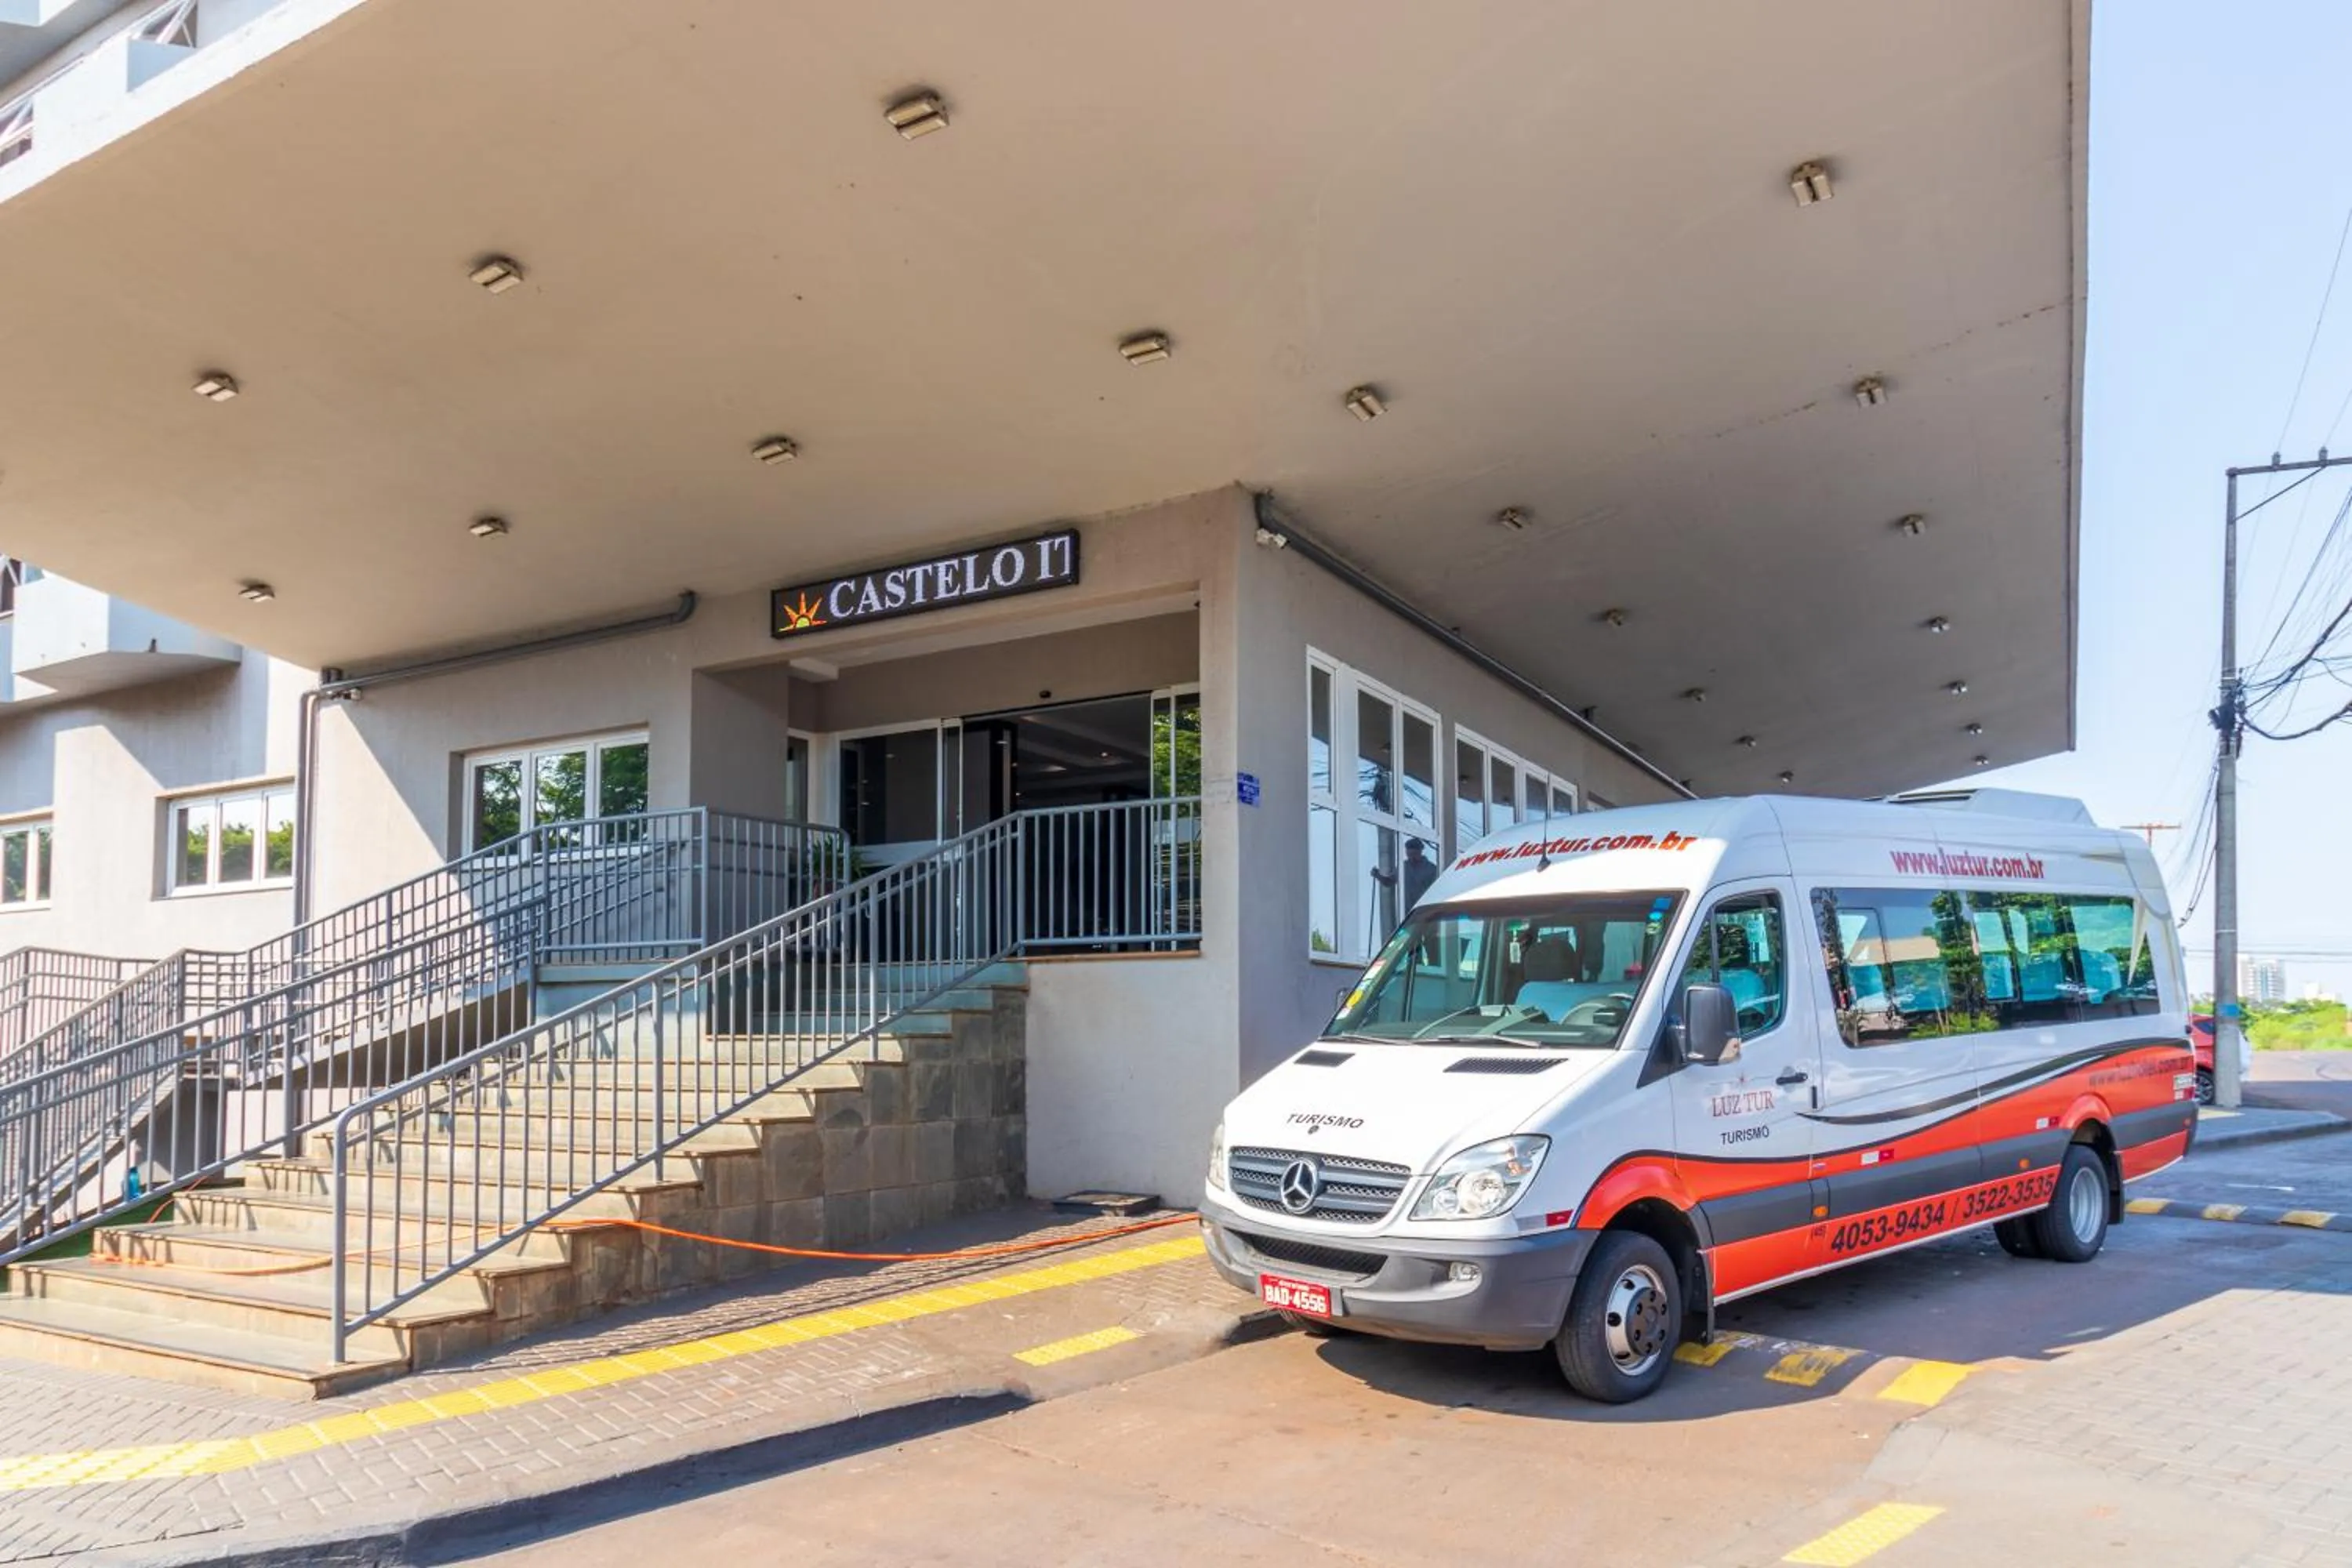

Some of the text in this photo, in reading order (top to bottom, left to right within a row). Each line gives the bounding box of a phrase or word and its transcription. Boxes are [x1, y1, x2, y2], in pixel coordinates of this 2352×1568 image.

[829, 546, 1025, 618] CASTELO
[1454, 831, 1698, 871] www.luztur.com.br
[1889, 847, 2045, 879] www.luztur.com.br
[1711, 1091, 1775, 1117] LUZ TUR
[1286, 1113, 1364, 1128] TURISMO
[1720, 1125, 1769, 1145] TURISMO
[1830, 1200, 1945, 1253] 4053-9434
[1963, 1174, 2056, 1219] 3522-3535
